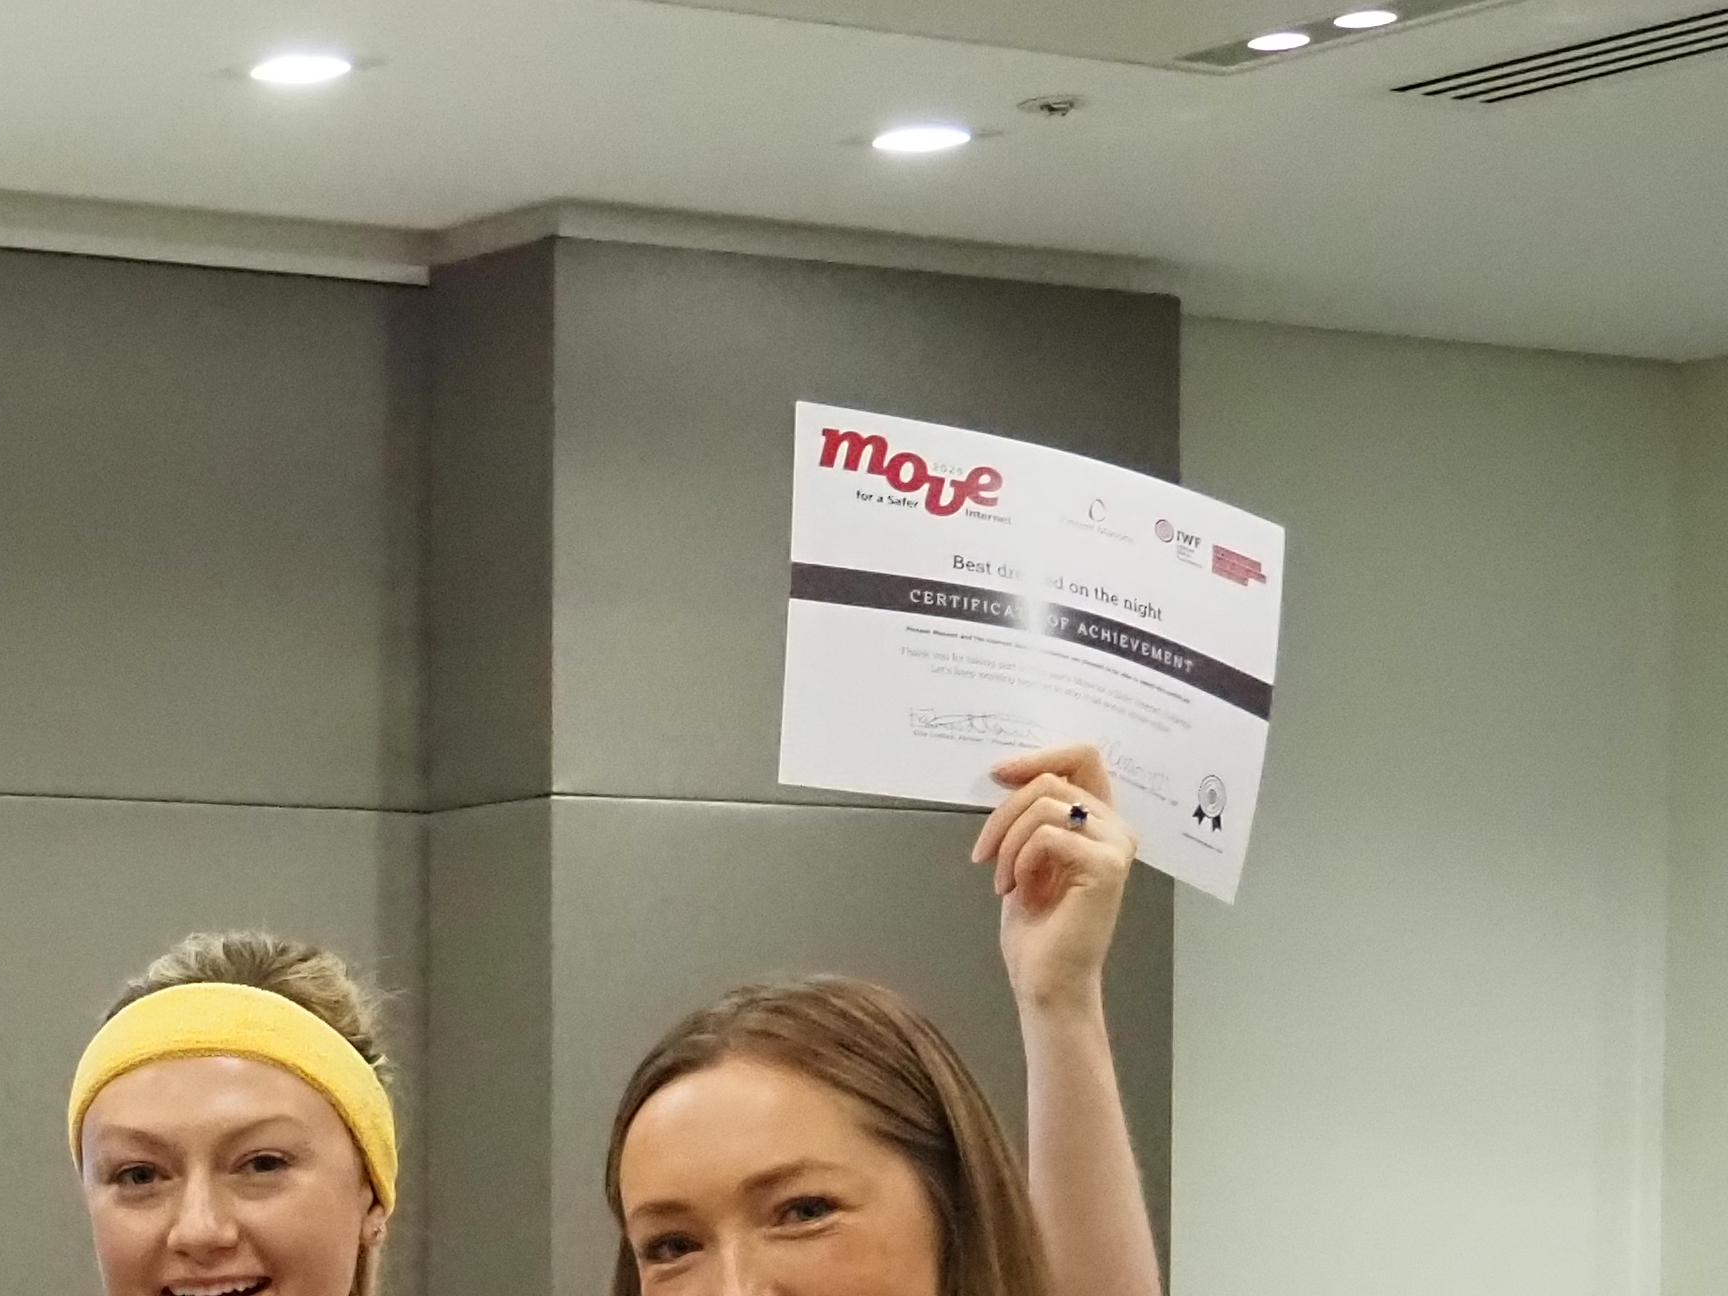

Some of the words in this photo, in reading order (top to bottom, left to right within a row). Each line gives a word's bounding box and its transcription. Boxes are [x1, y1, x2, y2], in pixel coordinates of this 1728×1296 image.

[819, 428, 1003, 516] move
[856, 490, 873, 502] for
[887, 495, 919, 509] Safer
[952, 555, 992, 575] Best
[1069, 580, 1089, 597] on
[1094, 586, 1119, 606] the
[1123, 597, 1163, 622] night
[909, 588, 1027, 619] CERTIFICA
[1047, 615, 1070, 631] OF
[1077, 623, 1194, 674] ACHIEVEMENT
